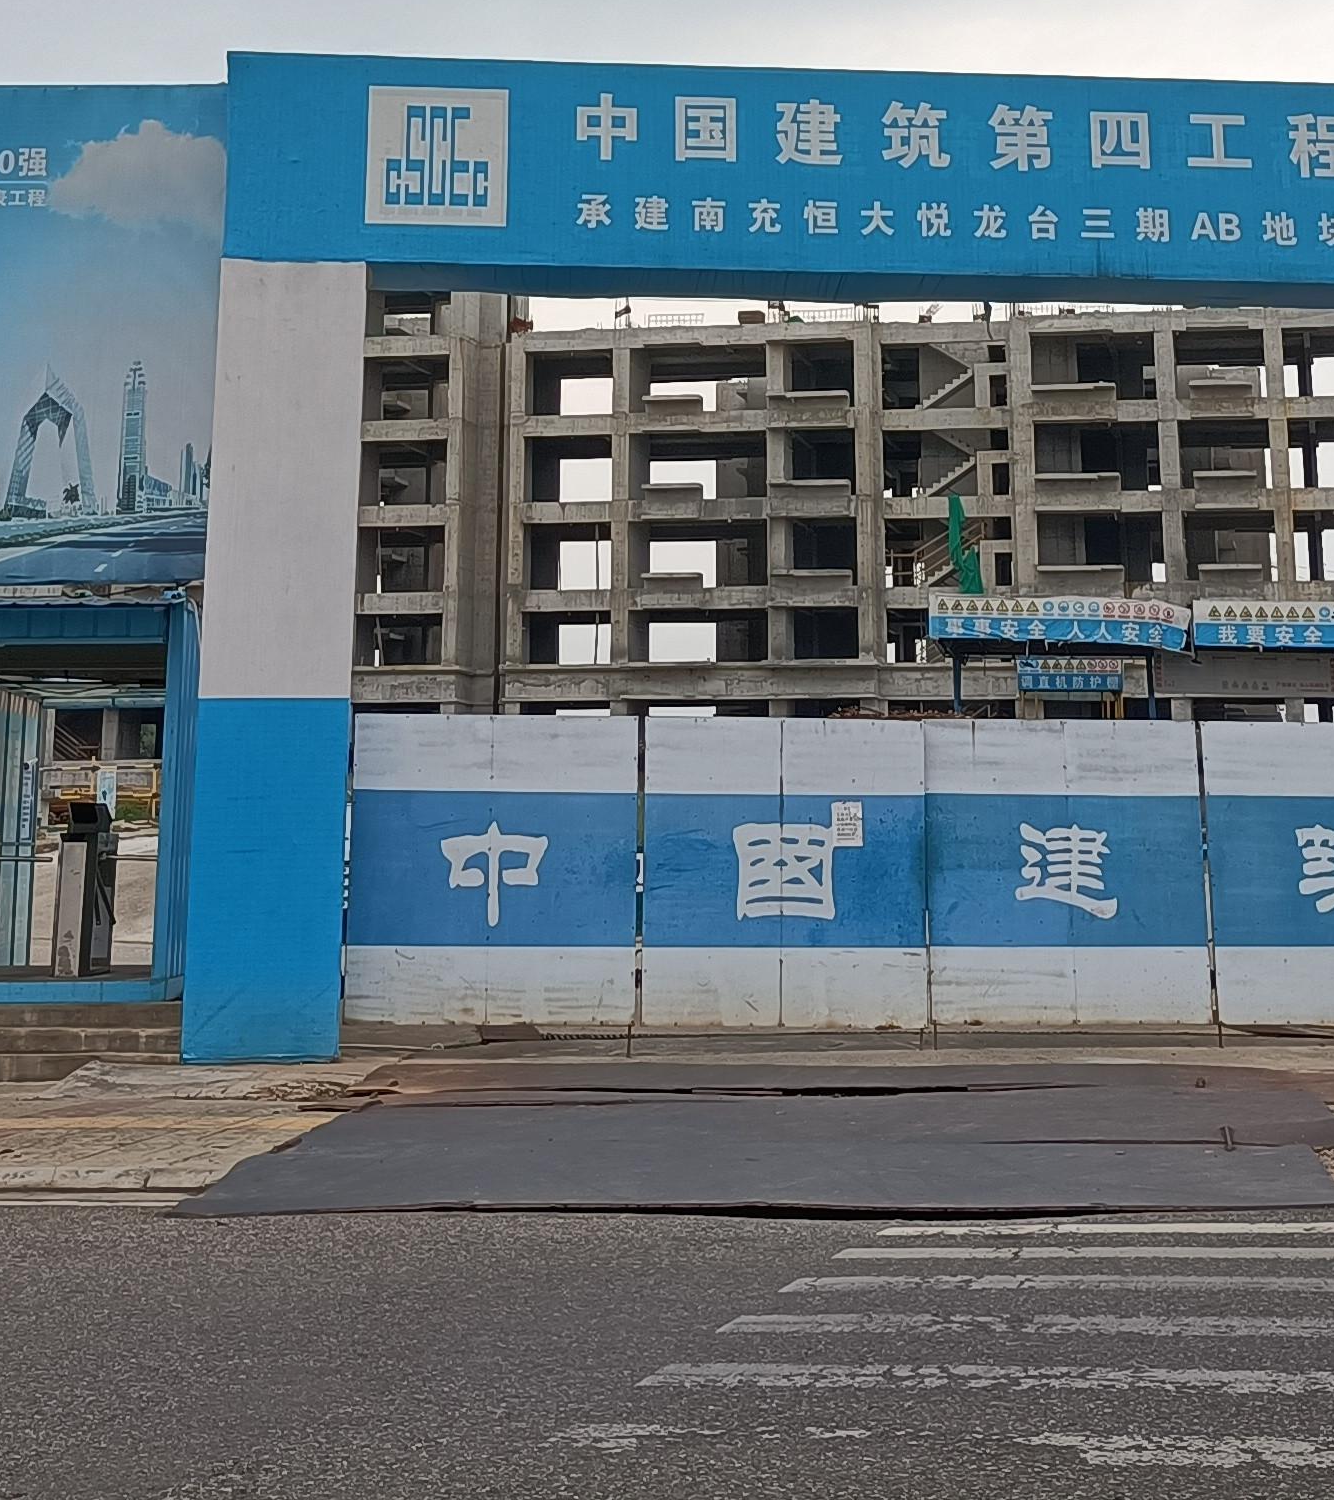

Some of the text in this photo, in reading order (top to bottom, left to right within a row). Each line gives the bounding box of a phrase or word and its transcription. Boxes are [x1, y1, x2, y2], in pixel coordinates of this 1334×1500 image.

[1067, 620, 1164, 645] 人人安全
[1218, 625, 1323, 646] 我要安全
[1020, 675, 1119, 690] 调直机防护棚
